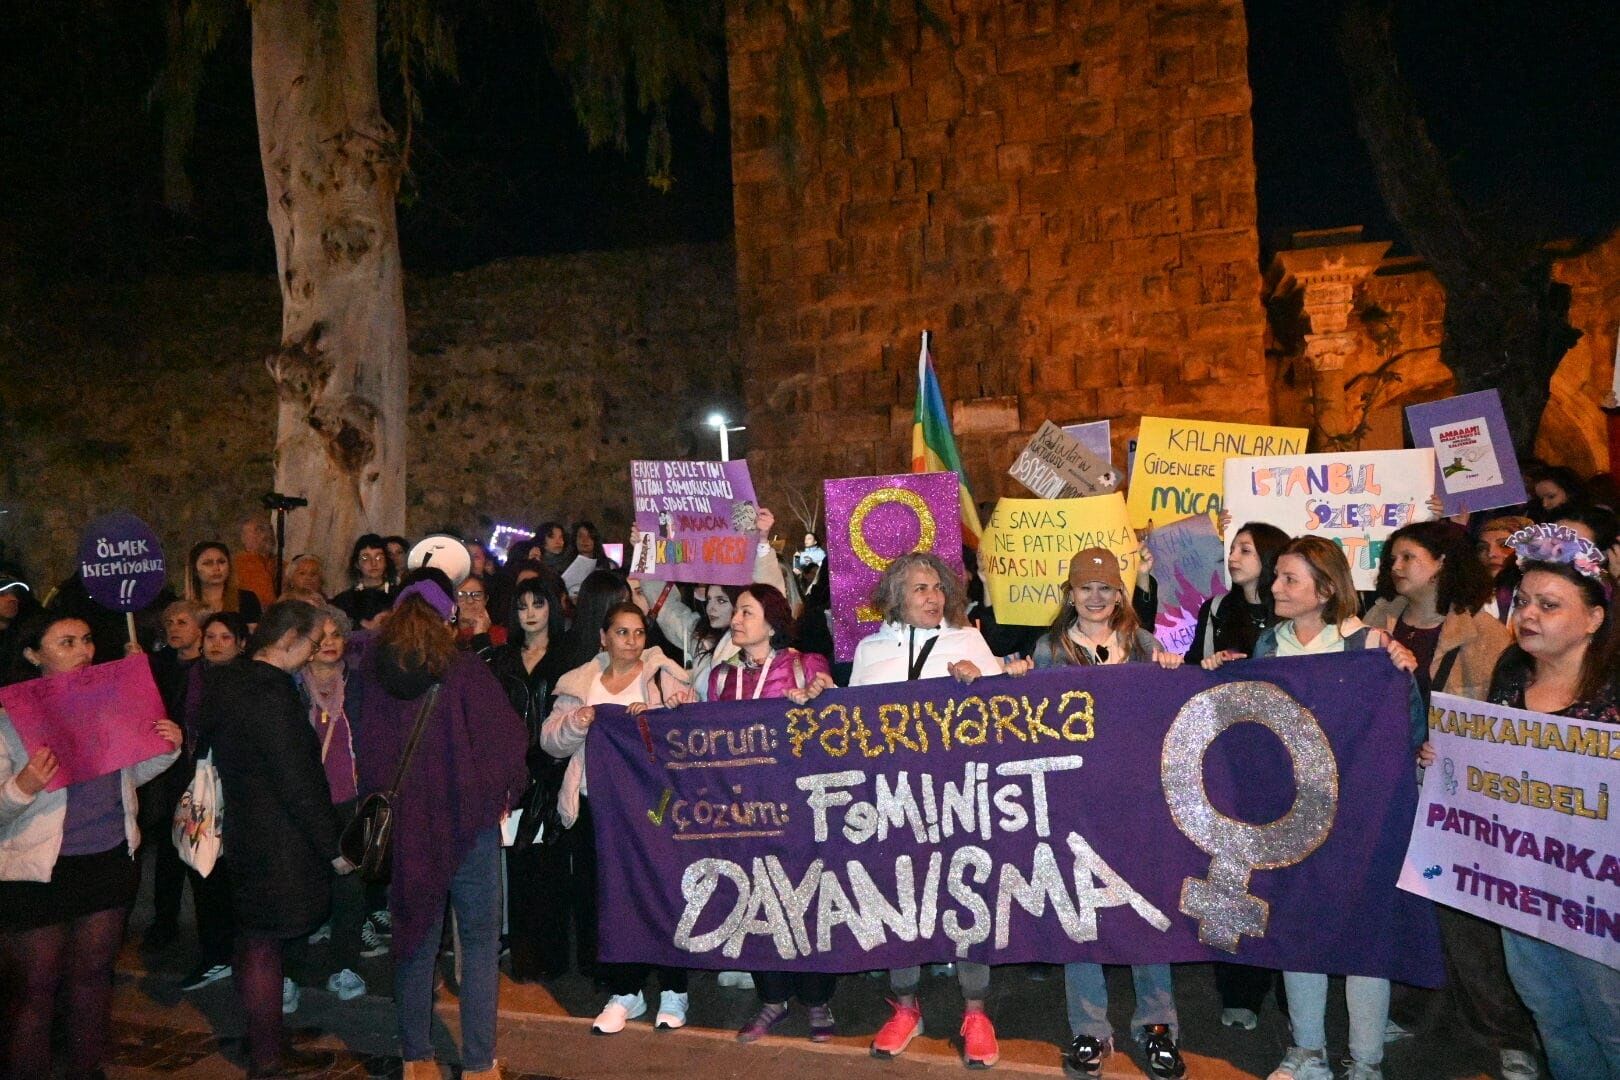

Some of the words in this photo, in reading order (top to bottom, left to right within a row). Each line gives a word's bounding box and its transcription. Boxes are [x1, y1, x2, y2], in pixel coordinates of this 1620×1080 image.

[1168, 429, 1300, 456] KALANLARIN
[633, 461, 661, 478] ERKEK
[1251, 462, 1381, 497] İSTANBUL
[636, 497, 660, 513] KOCA
[1151, 486, 1224, 515] MÜCA
[97, 537, 150, 558] ÖLMEK
[995, 533, 1015, 552] NE
[82, 558, 163, 578] İSTEMİYORUZ
[1466, 766, 1609, 820] DESİBELİ
[673, 831, 1172, 959] DAYANIŞMA
[1453, 862, 1620, 943] TİTRETSİN
